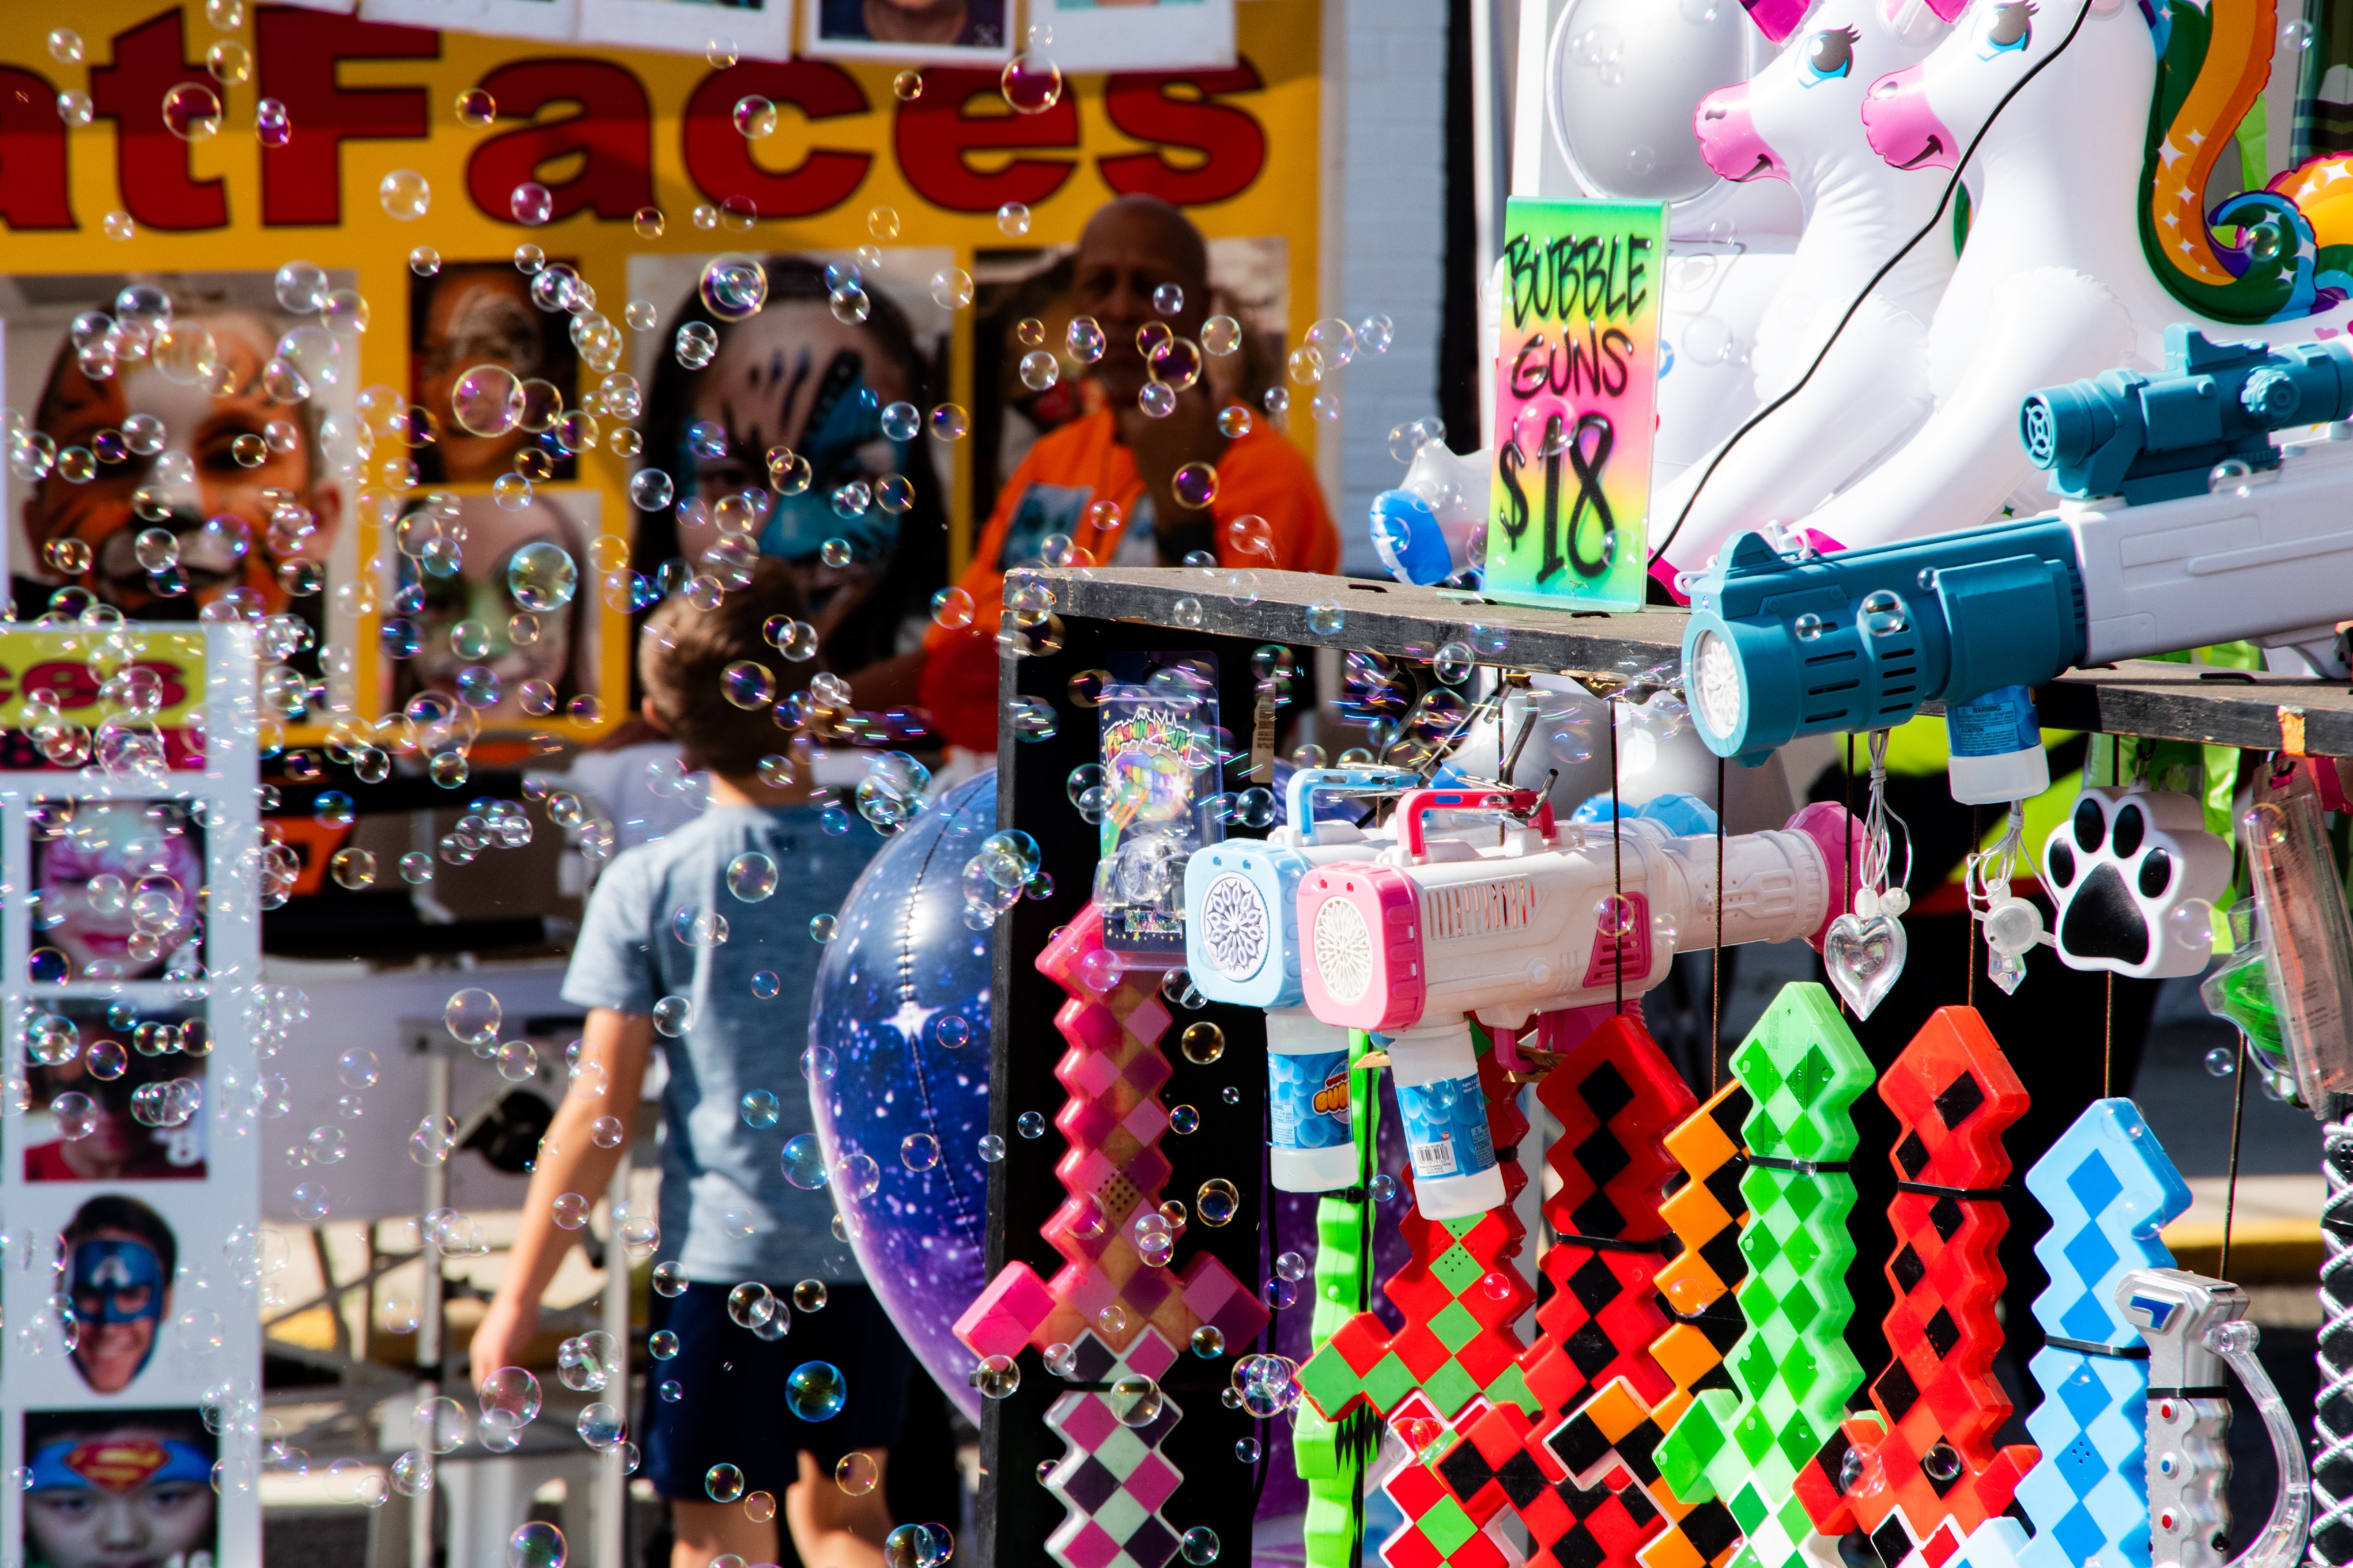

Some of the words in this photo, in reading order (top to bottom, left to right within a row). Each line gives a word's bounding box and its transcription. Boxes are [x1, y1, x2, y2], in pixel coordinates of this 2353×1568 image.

[1504, 233, 1653, 328] BUBBLE
[1511, 321, 1634, 399] GUNS
[1499, 412, 1615, 585] $18
[0, 660, 187, 710] es
[1106, 719, 1155, 761] FLASHING
[1153, 719, 1192, 761] MOUTH
